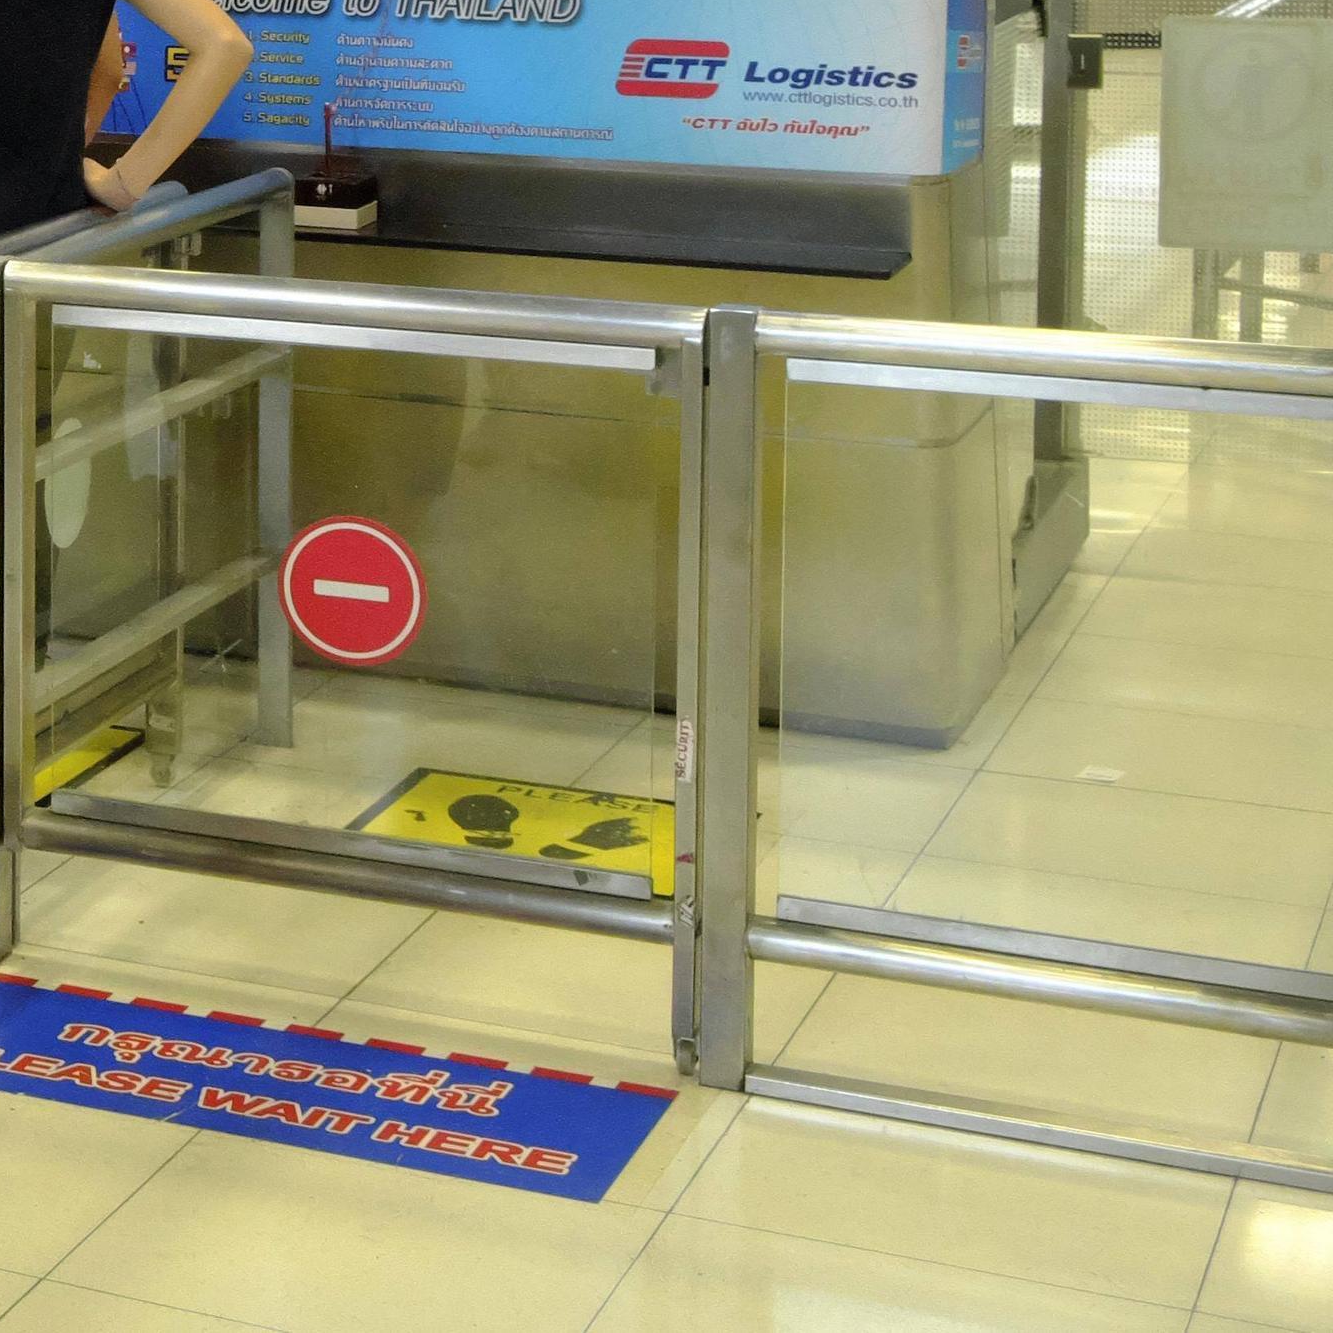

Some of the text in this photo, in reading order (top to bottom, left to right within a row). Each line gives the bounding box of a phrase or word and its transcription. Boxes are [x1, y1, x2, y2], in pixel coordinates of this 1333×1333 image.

[260, 30, 309, 45] Security
[259, 52, 303, 65] Service
[259, 73, 321, 88] Standards
[643, 57, 918, 90] CTT Logistics
[258, 92, 312, 106] Systems
[742, 88, 919, 109] www.cttlogistics.co.th
[258, 113, 310, 128] Sagacity
[496, 783, 659, 814] PLEASE
[60, 1021, 514, 1120] กรุณารอที่นี่
[197, 1086, 378, 1136] WAIT
[371, 1119, 577, 1175] HERE
